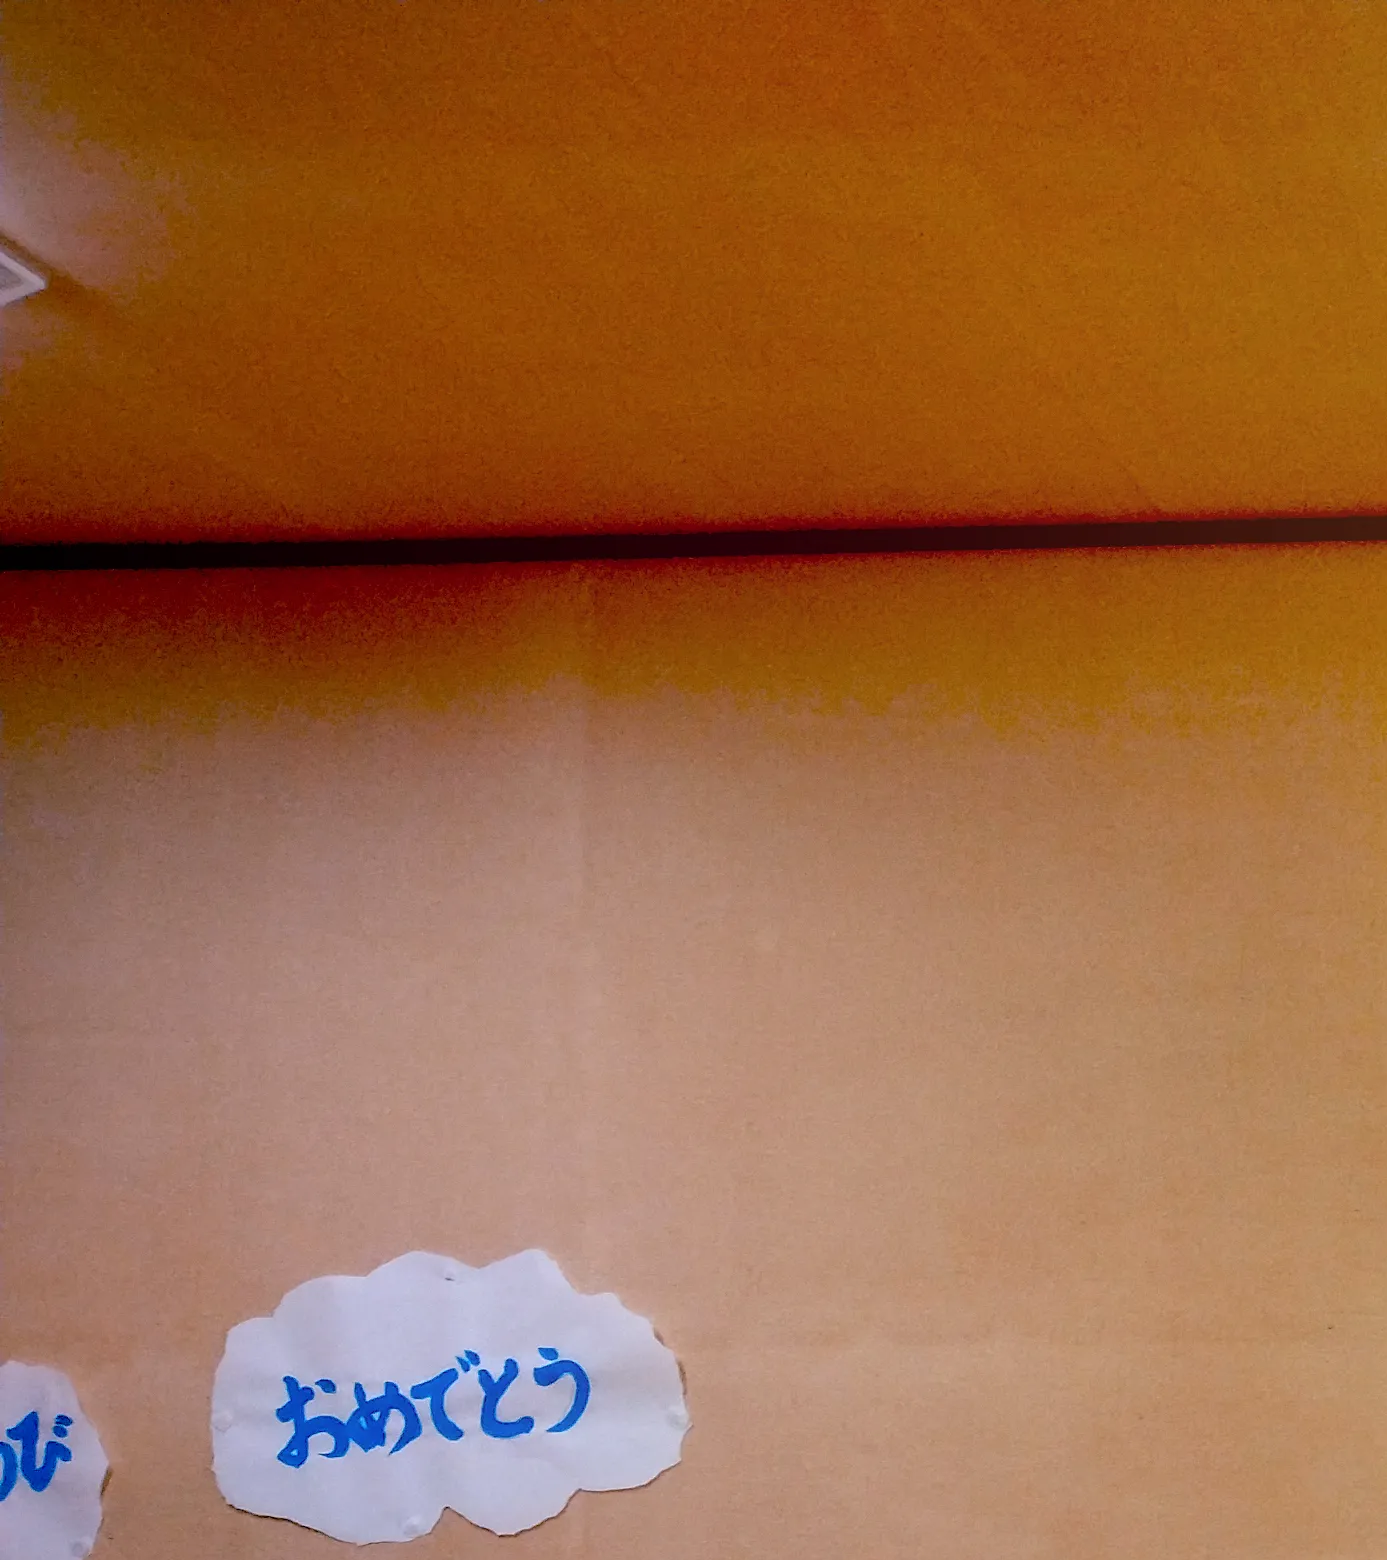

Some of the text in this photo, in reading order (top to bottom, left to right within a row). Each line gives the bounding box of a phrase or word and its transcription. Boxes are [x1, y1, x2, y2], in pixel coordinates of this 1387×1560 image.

[276, 1347, 590, 1468] おめでとう
